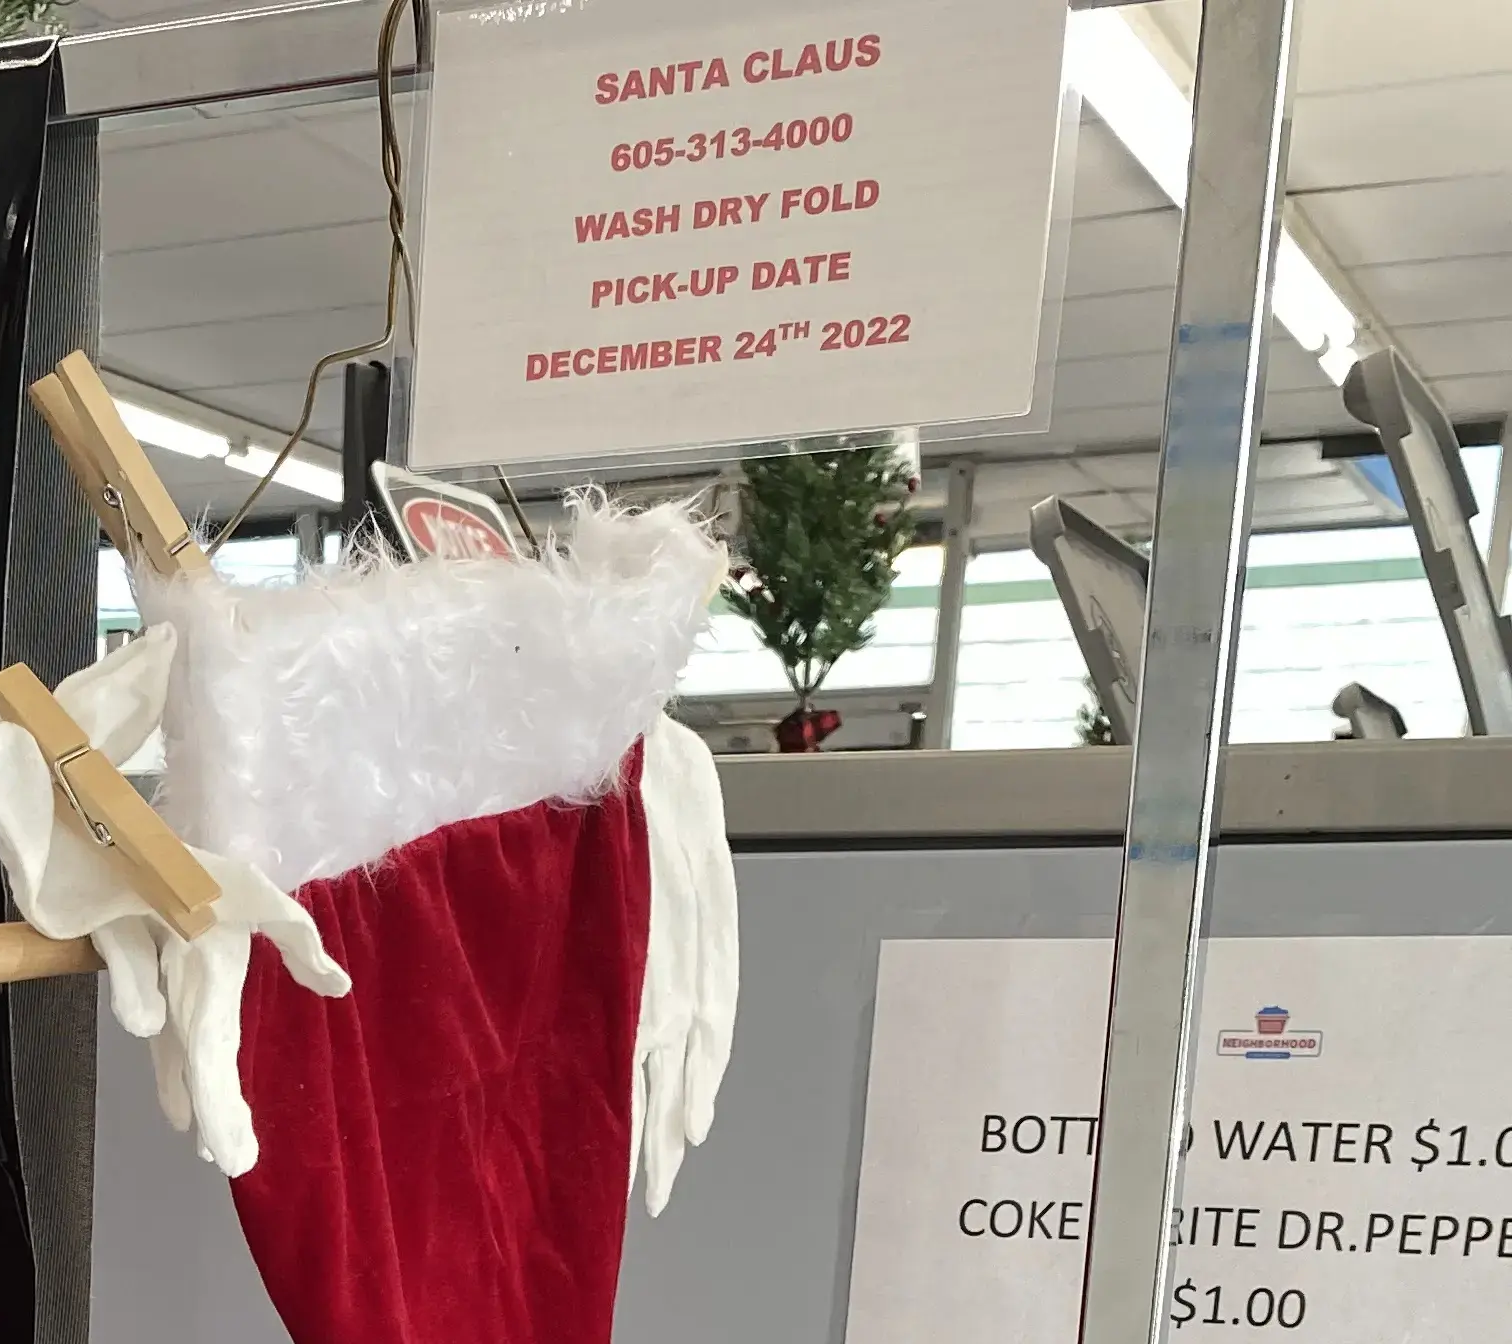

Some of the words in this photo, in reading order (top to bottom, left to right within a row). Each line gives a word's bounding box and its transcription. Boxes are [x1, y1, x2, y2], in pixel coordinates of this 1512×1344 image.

[594, 58, 729, 104] SANTA
[743, 34, 881, 83] CLAUS
[611, 112, 854, 172] 605-313-4000
[575, 204, 680, 243] WASH
[693, 193, 770, 229] DRY
[780, 179, 880, 219] FOLD
[591, 266, 739, 308] PICK-UP
[751, 252, 851, 290] DATE
[525, 335, 722, 381] DECEMBER
[733, 321, 811, 361] 24TH
[819, 314, 912, 351] 2022
[1222, 1037, 1317, 1050] NEIGHBORHOOD
[981, 1114, 1194, 1155] BOTT
[1214, 1119, 1393, 1164] WATER
[1411, 1118, 1512, 1172] $1.0
[959, 1198, 1083, 1240] COKE
[1170, 1206, 1260, 1247] RITE
[1278, 1210, 1512, 1258] DR.PEPPE
[1170, 1278, 1306, 1329] $1.00
